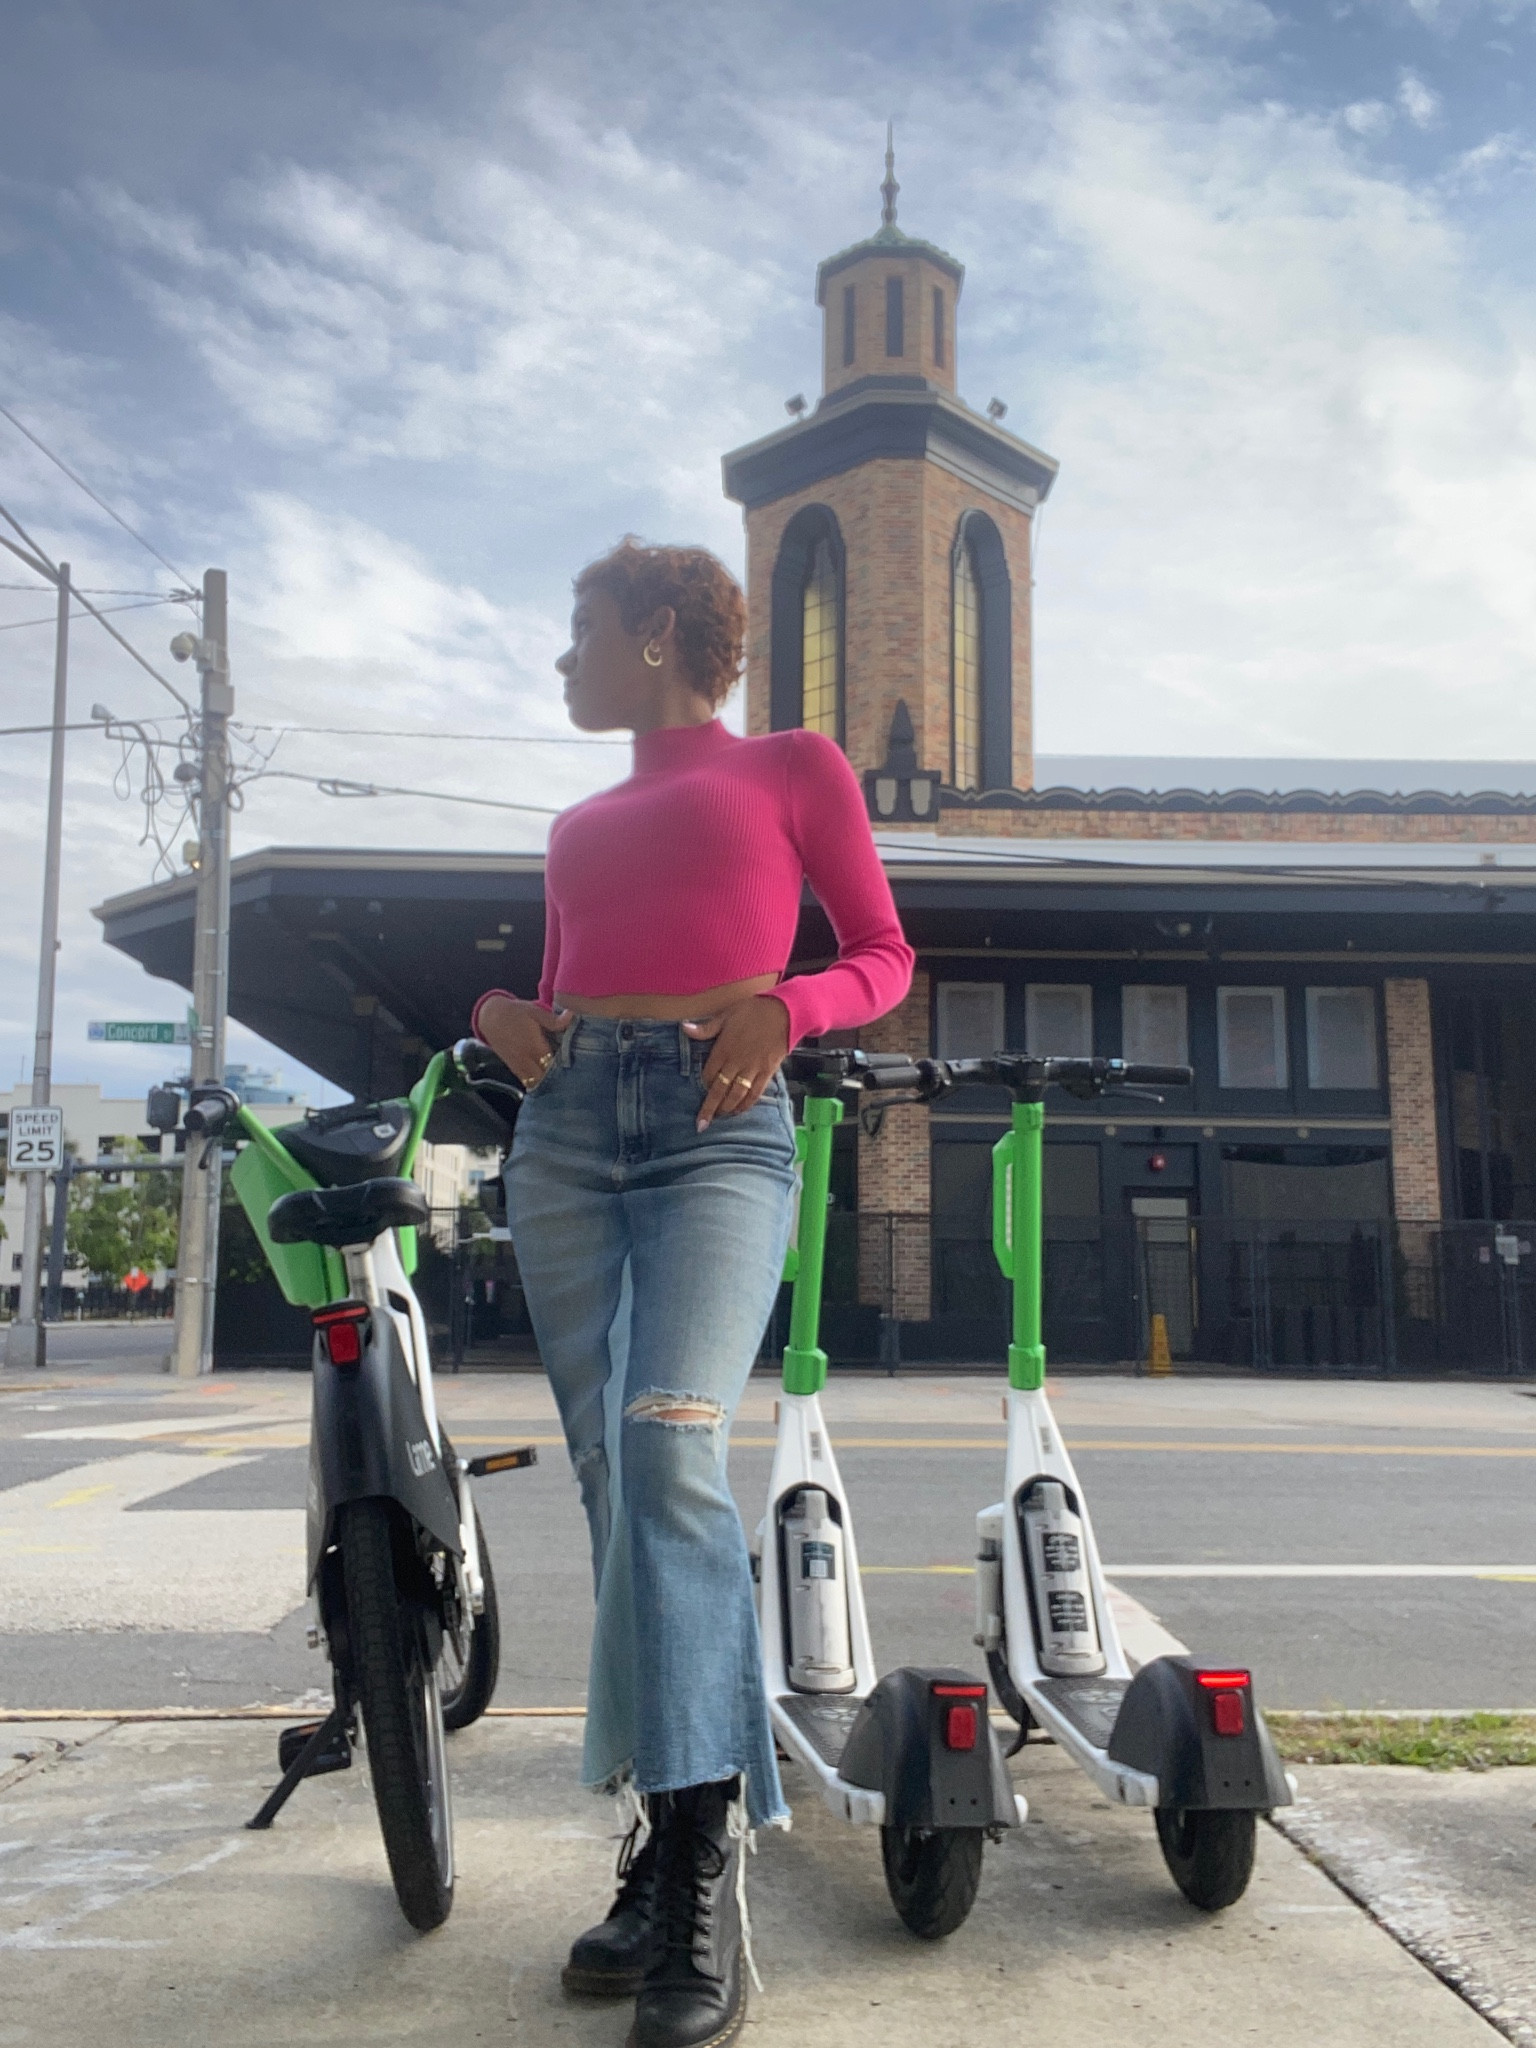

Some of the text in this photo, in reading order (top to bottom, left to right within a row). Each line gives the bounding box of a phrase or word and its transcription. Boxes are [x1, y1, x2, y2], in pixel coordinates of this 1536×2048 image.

[108, 1024, 158, 1040] Concord
[16, 1113, 59, 1124] SPEED
[19, 1126, 52, 1136] LIMIT
[16, 1141, 55, 1162] 25
